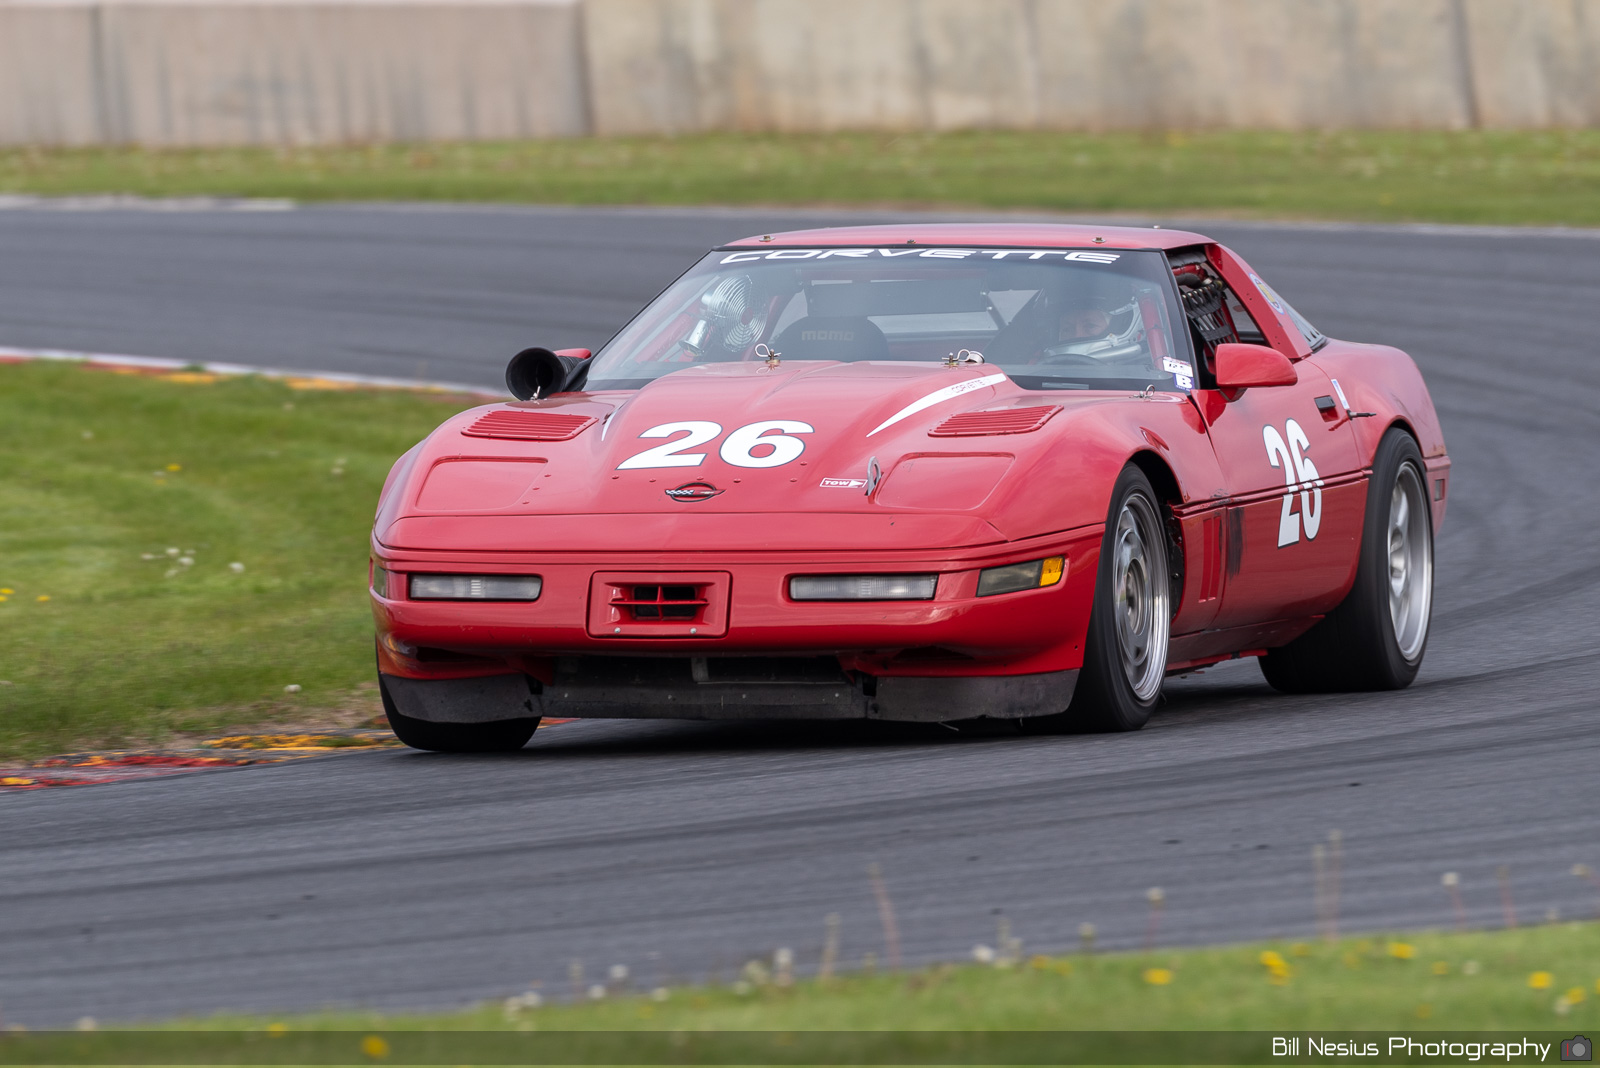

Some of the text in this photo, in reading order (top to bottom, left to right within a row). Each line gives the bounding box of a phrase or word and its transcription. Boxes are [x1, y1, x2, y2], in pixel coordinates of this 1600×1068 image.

[719, 248, 1121, 264] CORVETTE
[1176, 374, 1192, 388] B
[615, 420, 815, 469] 26
[1262, 417, 1323, 549] 26
